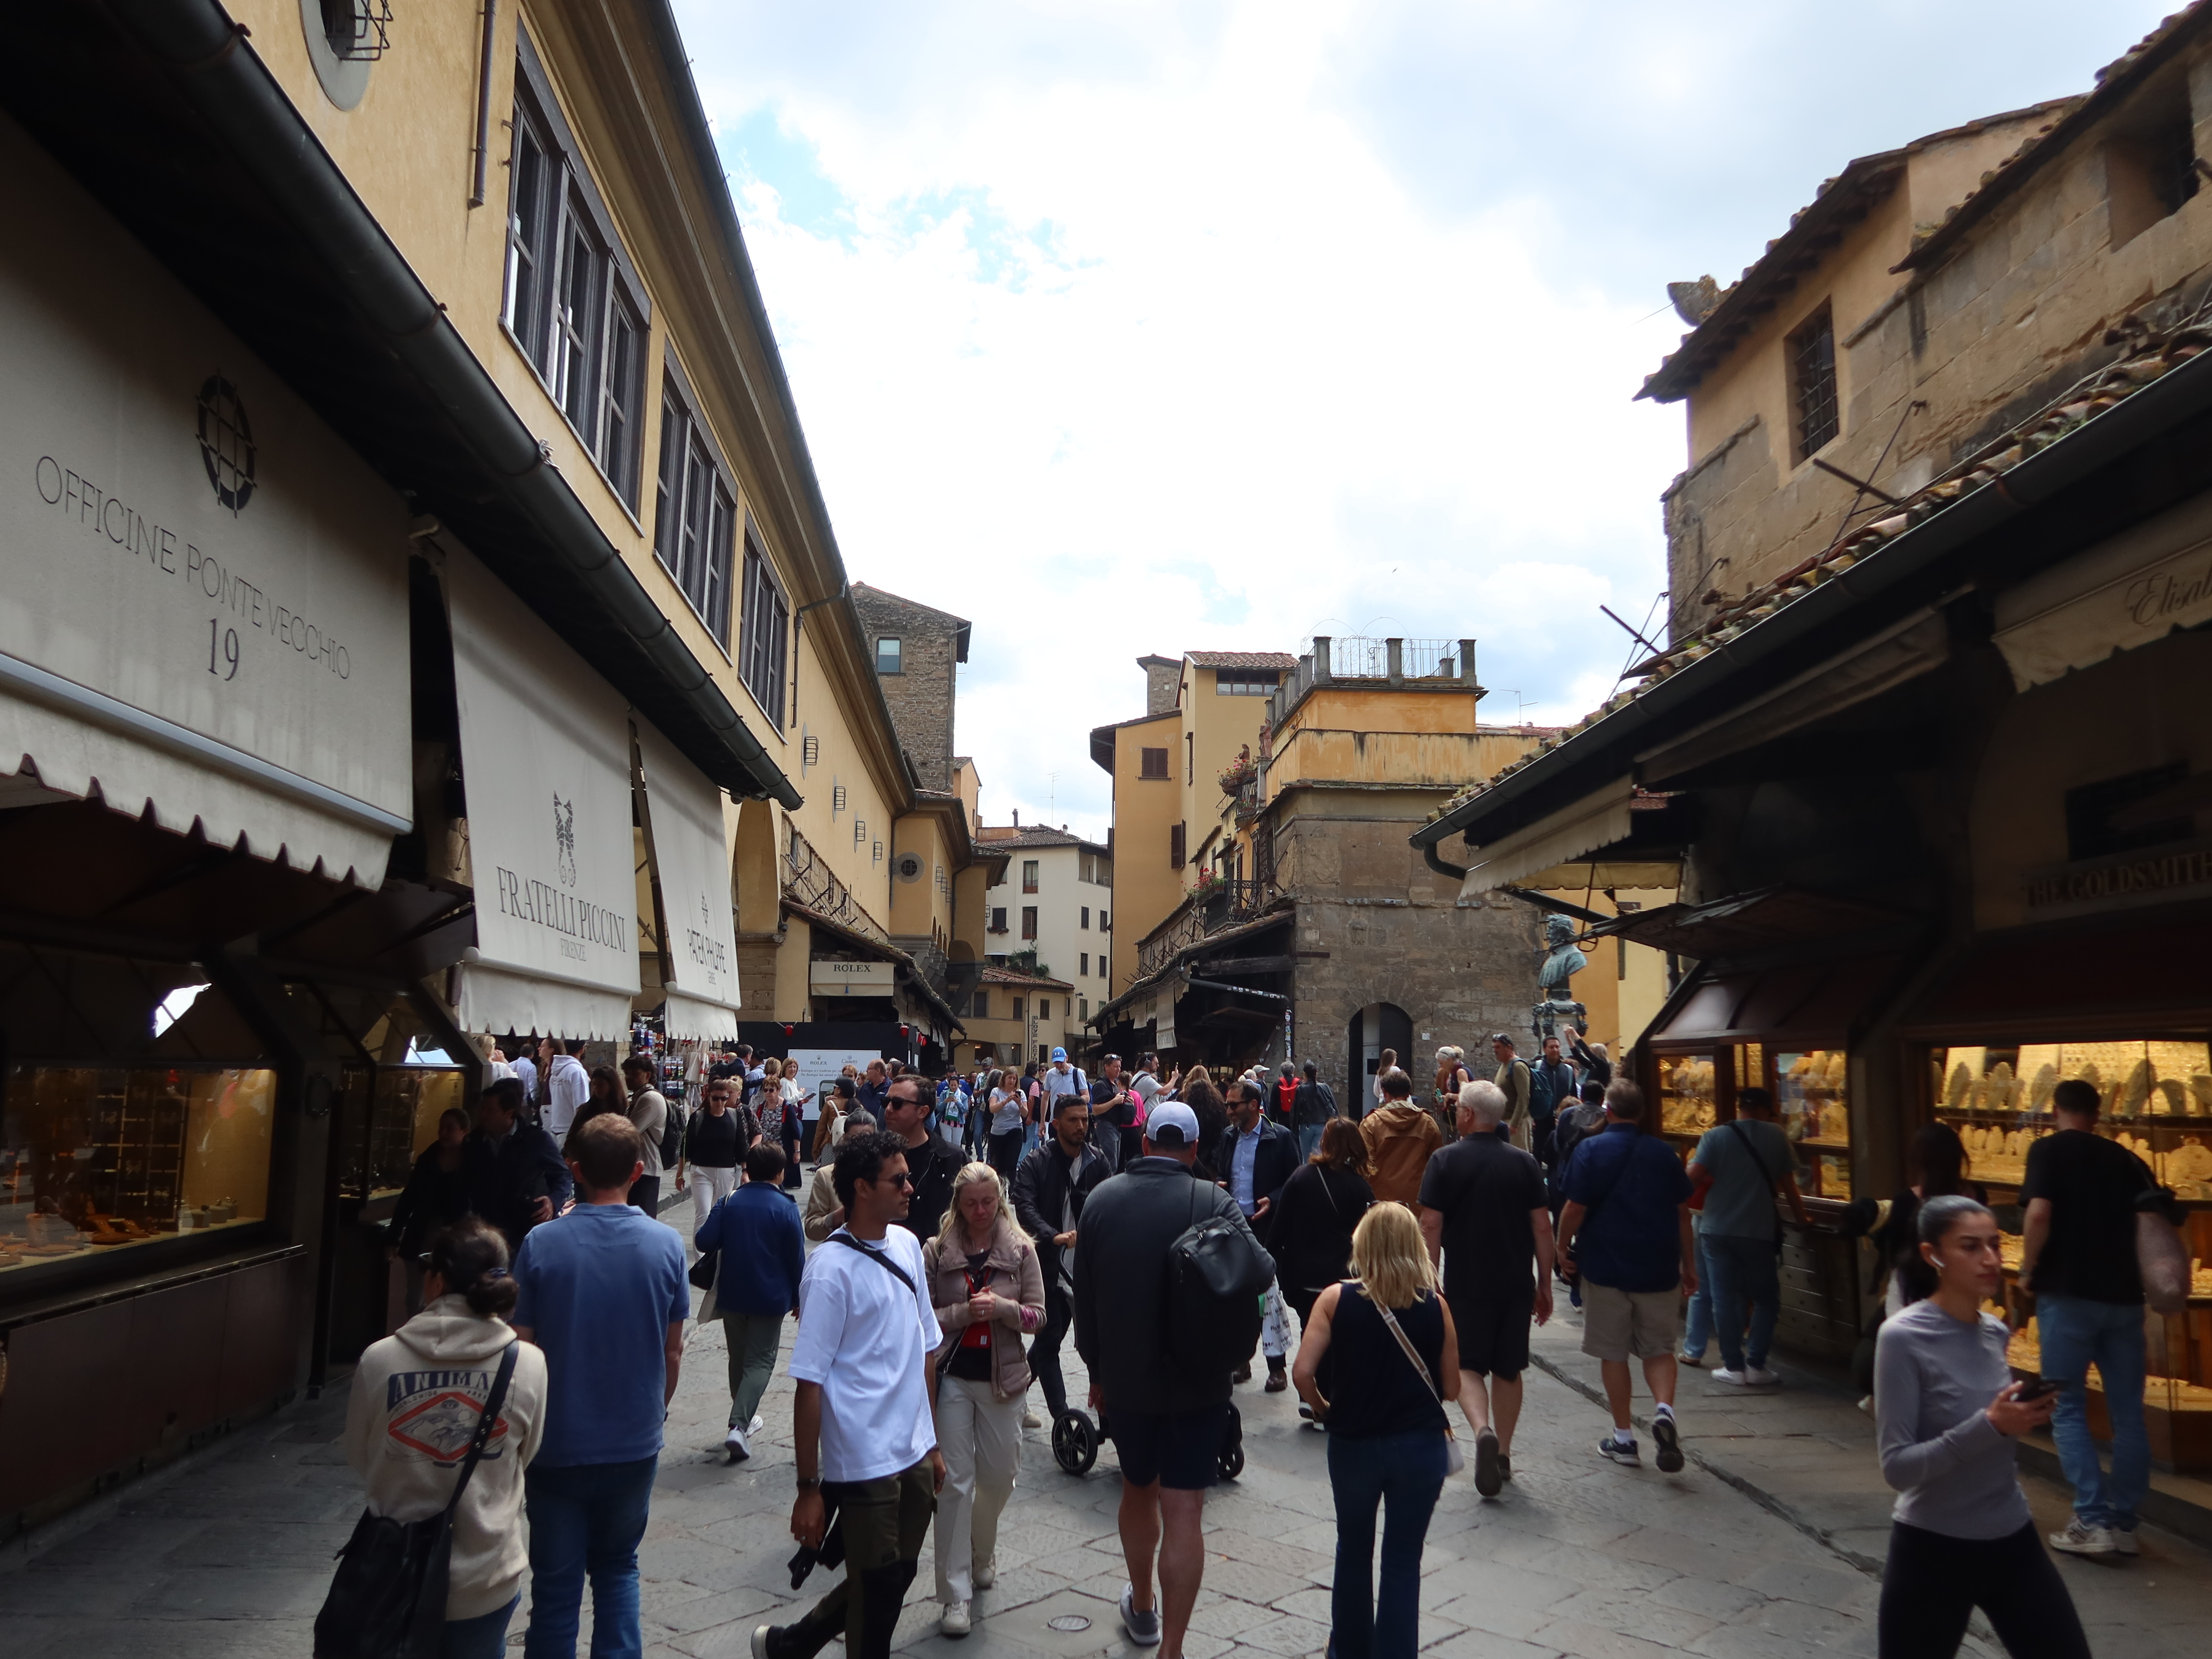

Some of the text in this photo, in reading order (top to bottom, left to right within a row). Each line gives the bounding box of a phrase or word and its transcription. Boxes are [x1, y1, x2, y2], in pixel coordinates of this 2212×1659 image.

[36, 456, 350, 679] OFFICINE PONTE VECCHIO
[208, 618, 239, 681] 19
[496, 866, 626, 953] FRATELLI PICCINI
[560, 938, 587, 962] FIRENZE
[687, 928, 708, 966] PATEK
[833, 964, 871, 972] ROLEX
[393, 1371, 489, 1403] ANIMA
